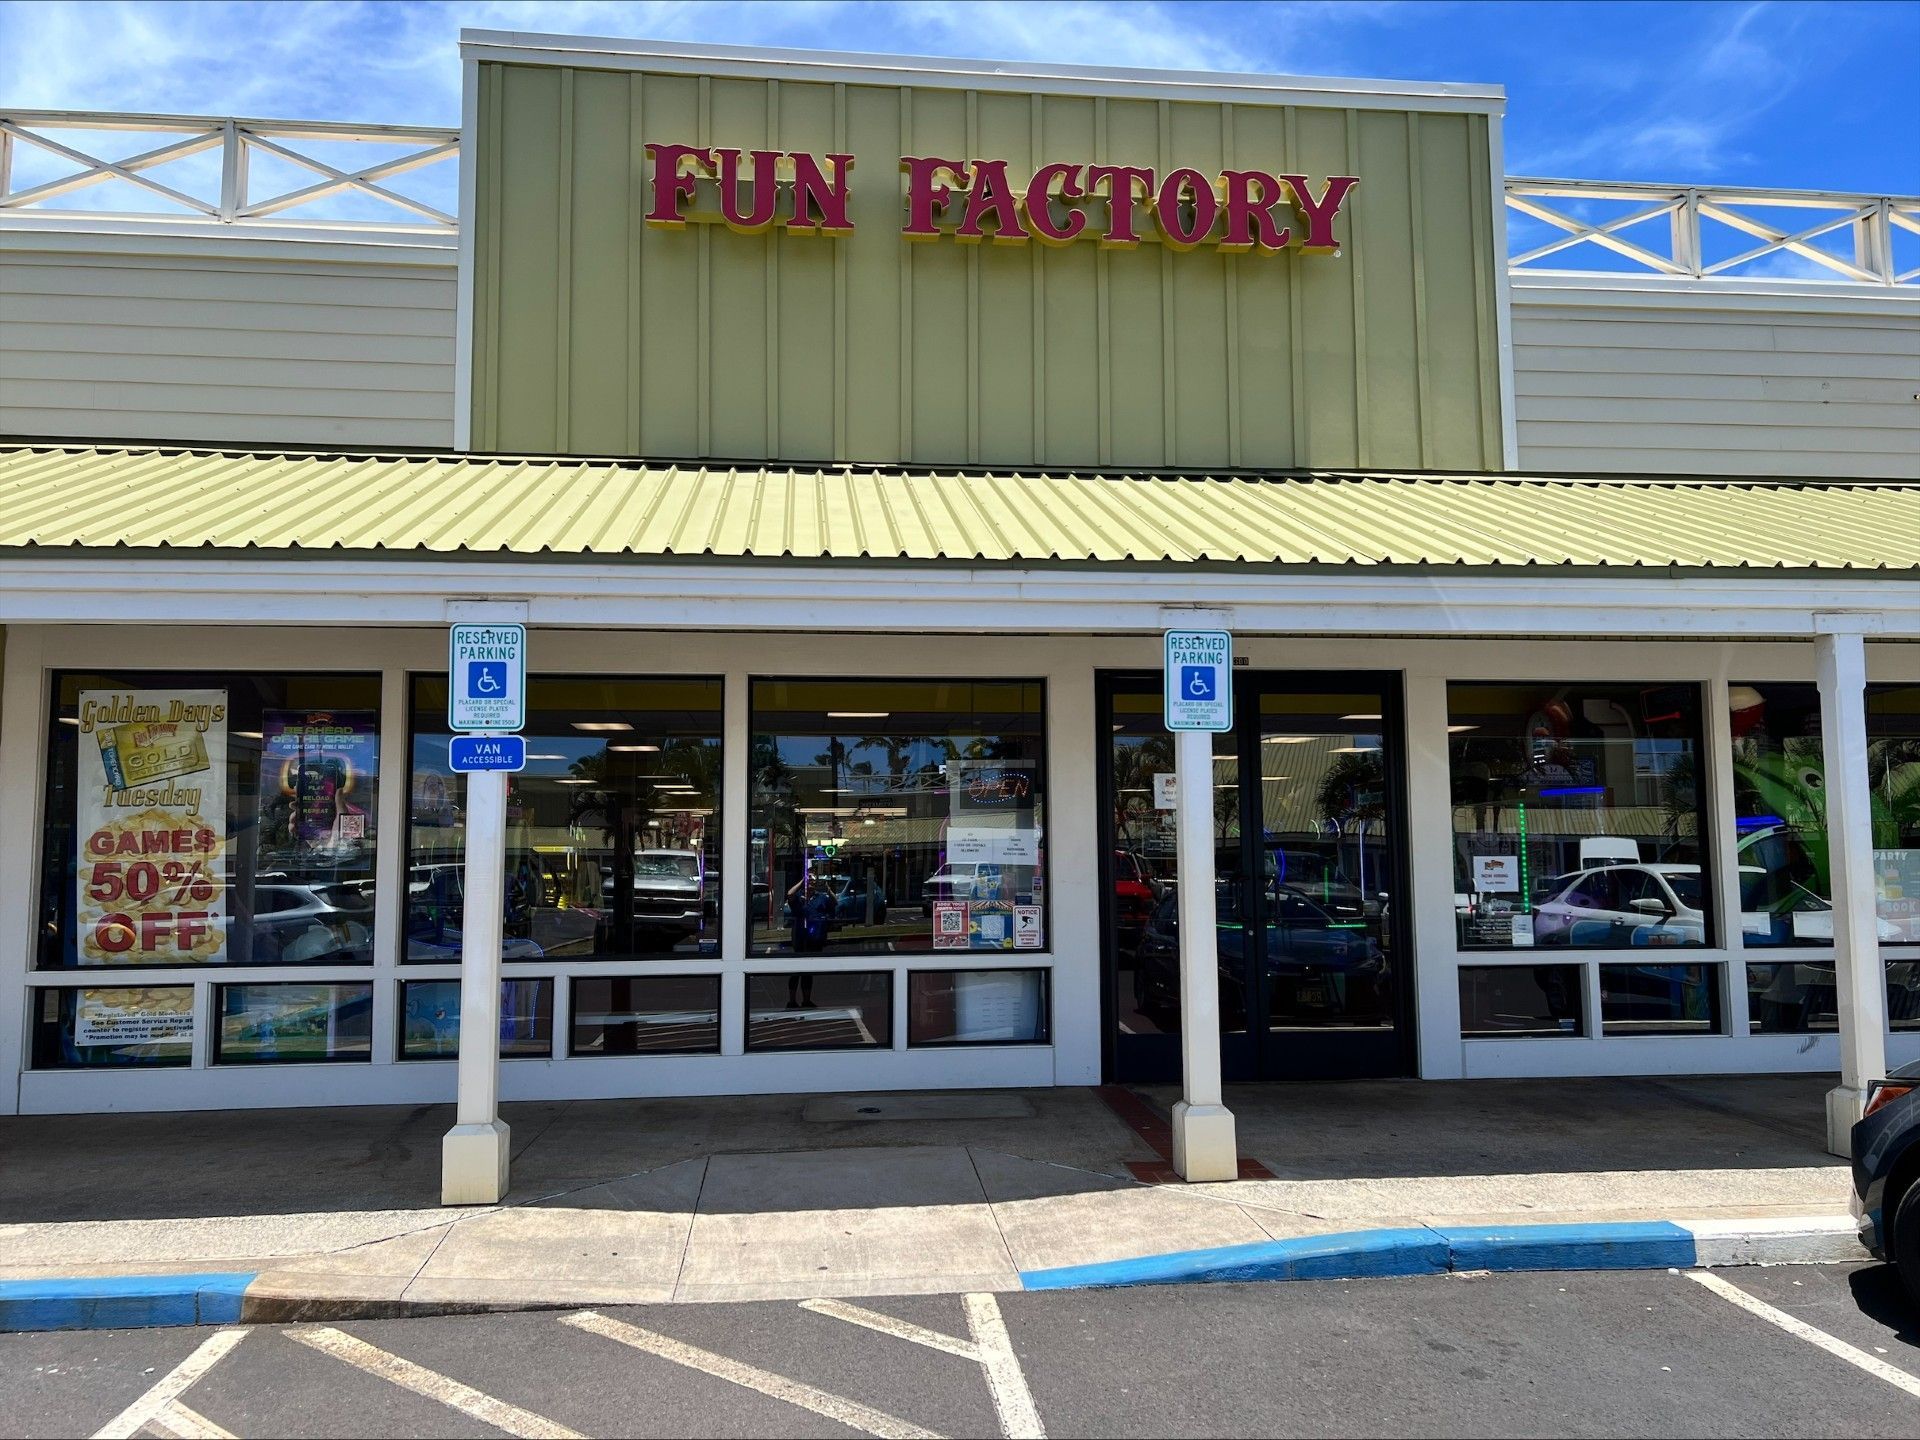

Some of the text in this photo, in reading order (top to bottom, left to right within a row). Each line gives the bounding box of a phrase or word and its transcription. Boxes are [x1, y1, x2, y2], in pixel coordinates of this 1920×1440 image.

[644, 142, 1361, 255] FUN FACTORY
[457, 631, 519, 645] RESERVED
[1170, 637, 1226, 650] RESERVED
[460, 647, 516, 660] PARKING
[1173, 651, 1223, 665] PARKING
[80, 694, 226, 733] Golden Days
[283, 726, 354, 734] BE AHEAD
[271, 735, 365, 743] OF THE GAME
[475, 743, 501, 754] VAN
[128, 745, 192, 768] GOLD
[462, 755, 513, 764] ACCESSIBLE
[968, 779, 1030, 799] OPEN
[103, 779, 202, 816] Tuesday
[89, 829, 216, 855] GAMES
[1873, 851, 1908, 861] PARTY
[90, 860, 213, 904] 50%
